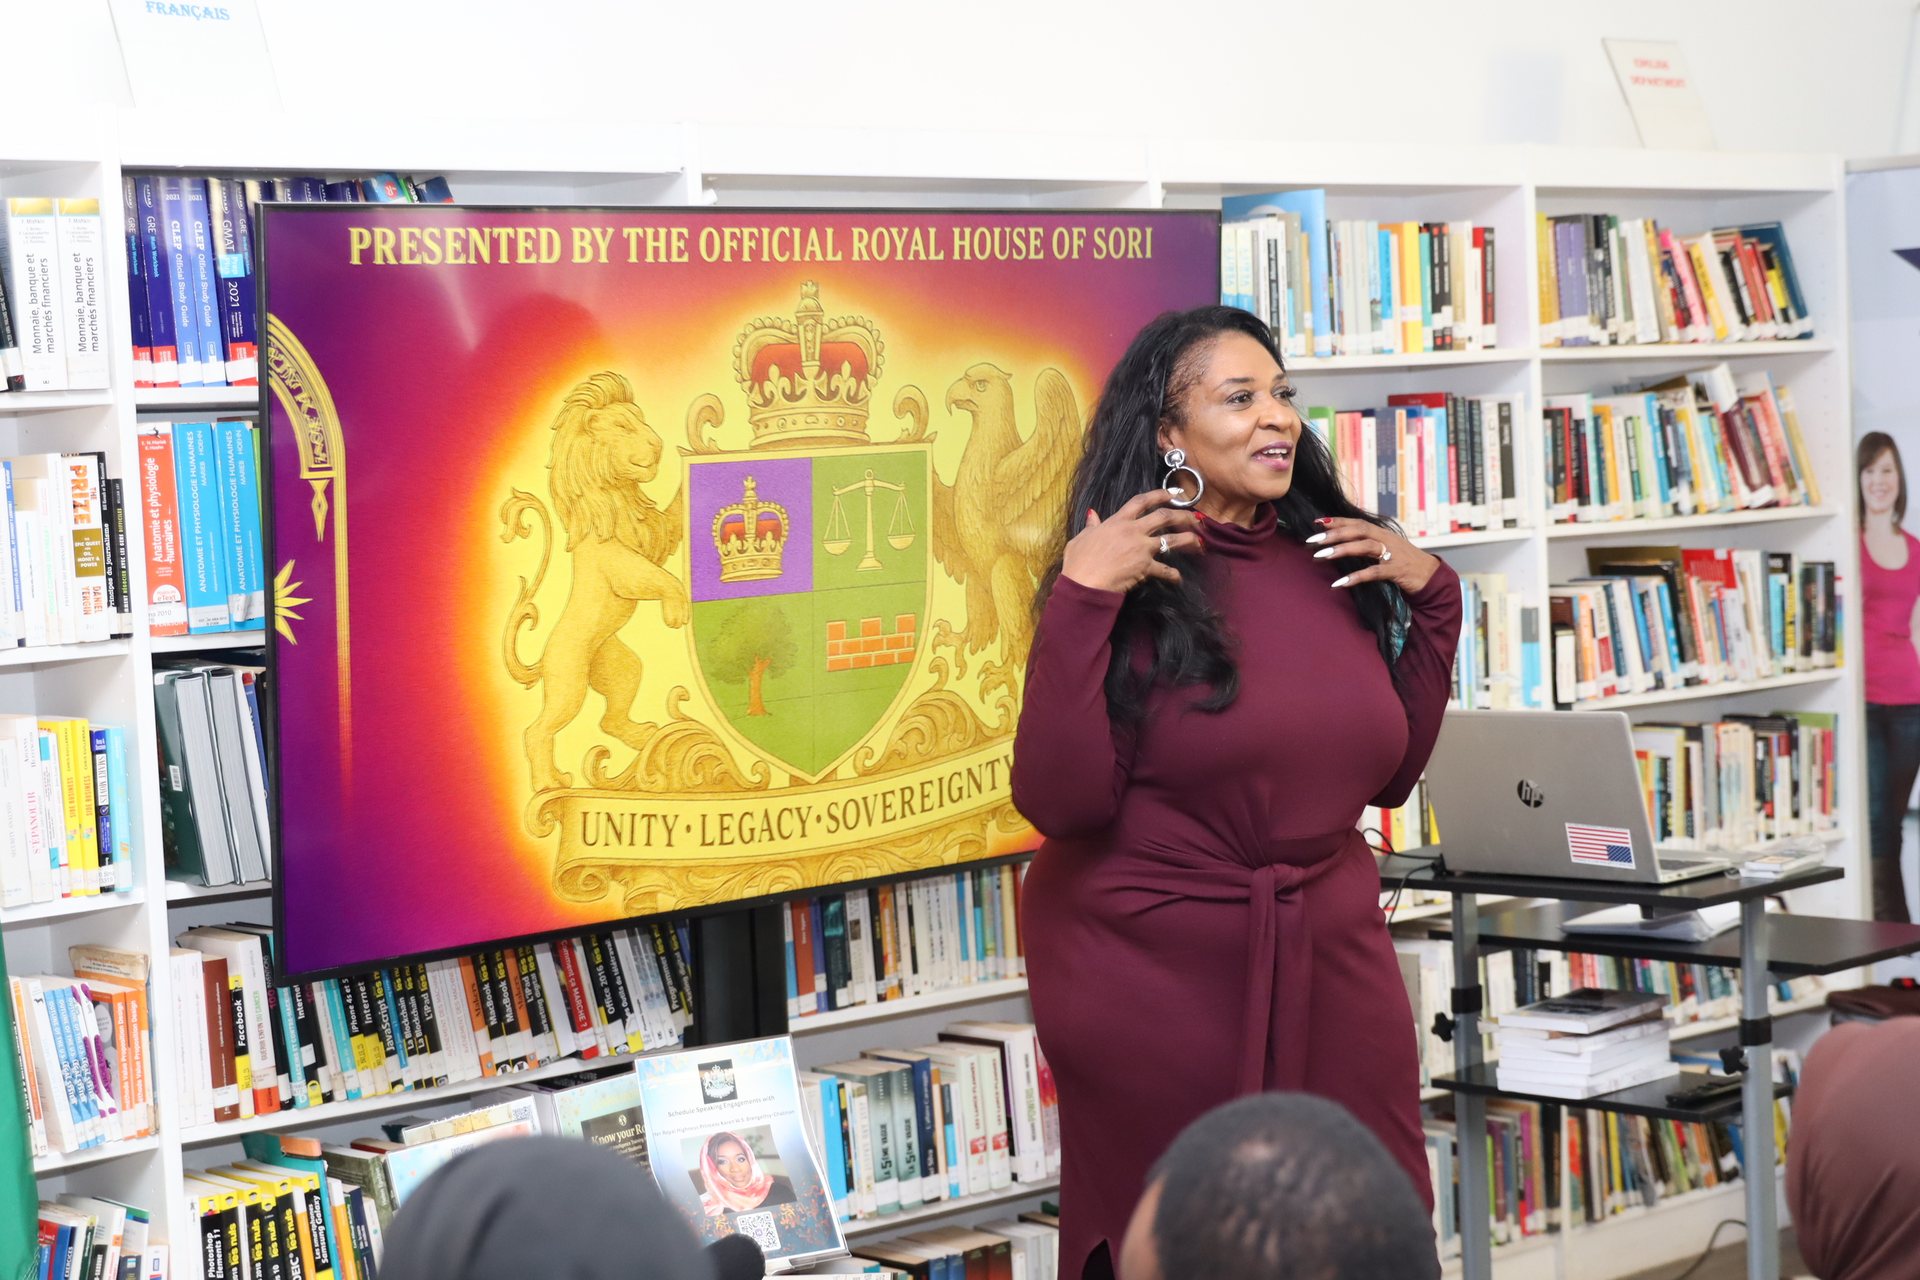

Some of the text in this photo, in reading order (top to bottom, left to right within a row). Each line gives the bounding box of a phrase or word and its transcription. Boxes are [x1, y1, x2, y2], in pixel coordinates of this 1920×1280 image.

[145, 1, 230, 21] FRANÇAIS
[146, 216, 156, 234] GRE
[171, 220, 182, 250] CLEP
[194, 220, 205, 250] CLEP
[223, 220, 234, 252] GMAT
[348, 226, 1153, 265] PRESENTED BY THE OFFICIAL ROYAL HOUSE OF SORI
[176, 254, 184, 280] Official
[198, 254, 207, 281] Official
[27, 254, 42, 354] Monnaie, banque et
[40, 258, 54, 354] marchés financiers
[73, 253, 87, 352] Monnaie, banque et
[85, 257, 99, 352] marchés financiers
[229, 281, 238, 307] 2021
[235, 430, 243, 454] HOEHN
[70, 464, 92, 524] PRIZE
[144, 458, 162, 507] physiologie
[150, 508, 159, 518] et
[186, 431, 206, 592] ANATOMIE ET PHYSIOLOGIE HUMAINES
[226, 430, 246, 590] ANATOMIE ET PHYSIOLOGIE HUMAINES
[104, 524, 113, 575] du journalisme
[149, 520, 163, 562] Anatomie
[162, 520, 175, 563] humaines
[82, 586, 92, 615] YERGIN
[93, 586, 102, 614] DANIEL
[98, 755, 106, 780] SMART
[84, 776, 92, 803] BUSINESS
[99, 781, 108, 804] MOVES
[580, 810, 680, 848] UNITY
[699, 805, 812, 848] LEGACY
[263, 955, 276, 1009] 100 INVENTIONS
[480, 964, 497, 1026] MacBook les
[497, 962, 514, 1023] MacBook les
[515, 976, 524, 1009] Makers
[520, 958, 533, 1003] L'iPad les
[527, 955, 541, 998] digital les
[561, 940, 585, 1022] Comment MARCHE
[592, 947, 615, 1014] Office 2016 les
[605, 940, 628, 1008] Outils du télétravail
[655, 939, 680, 1010] Programmer les
[253, 991, 266, 1040] ENFIN CANCER
[294, 985, 305, 1019] Internet
[344, 985, 359, 1033] iPhone et
[358, 981, 372, 1024] Internet
[375, 980, 395, 1051] JavaScript les
[419, 974, 432, 1021] L'iPad les
[471, 983, 480, 1016] Makers
[49, 1002, 58, 1027] OUTLINE
[61, 1060, 72, 1081] LEGAL
[59, 1001, 68, 1026] OUTLINE
[71, 1059, 81, 1078] LEGAL
[69, 997, 90, 1077] OUTLINE LEGAL
[119, 1025, 127, 1062] Proposition
[132, 1024, 141, 1060] Proposition
[234, 999, 246, 1046] Facebook
[398, 996, 414, 1050] La Blockchain
[410, 996, 425, 1048] La Blockchain
[668, 1109, 695, 1117] Schedule
[696, 1104, 722, 1113] Speaking
[723, 1098, 761, 1109] Engagements
[904, 1119, 912, 1139] VAGUE
[592, 1128, 635, 1145] Know your
[880, 1123, 888, 1144] VAGUE
[213, 1229, 221, 1237] 11
[229, 1222, 239, 1266] les nuls
[252, 1218, 260, 1242] nuls
[268, 1220, 279, 1258] les nuls
[285, 1208, 297, 1250] les nuls
[309, 1203, 319, 1247] smartphones
[313, 1196, 329, 1263] Samsung Galaxy
[65, 1246, 73, 1278] EXERCICES
[206, 1232, 216, 1278] Photoshop
[254, 1242, 263, 1261] les
